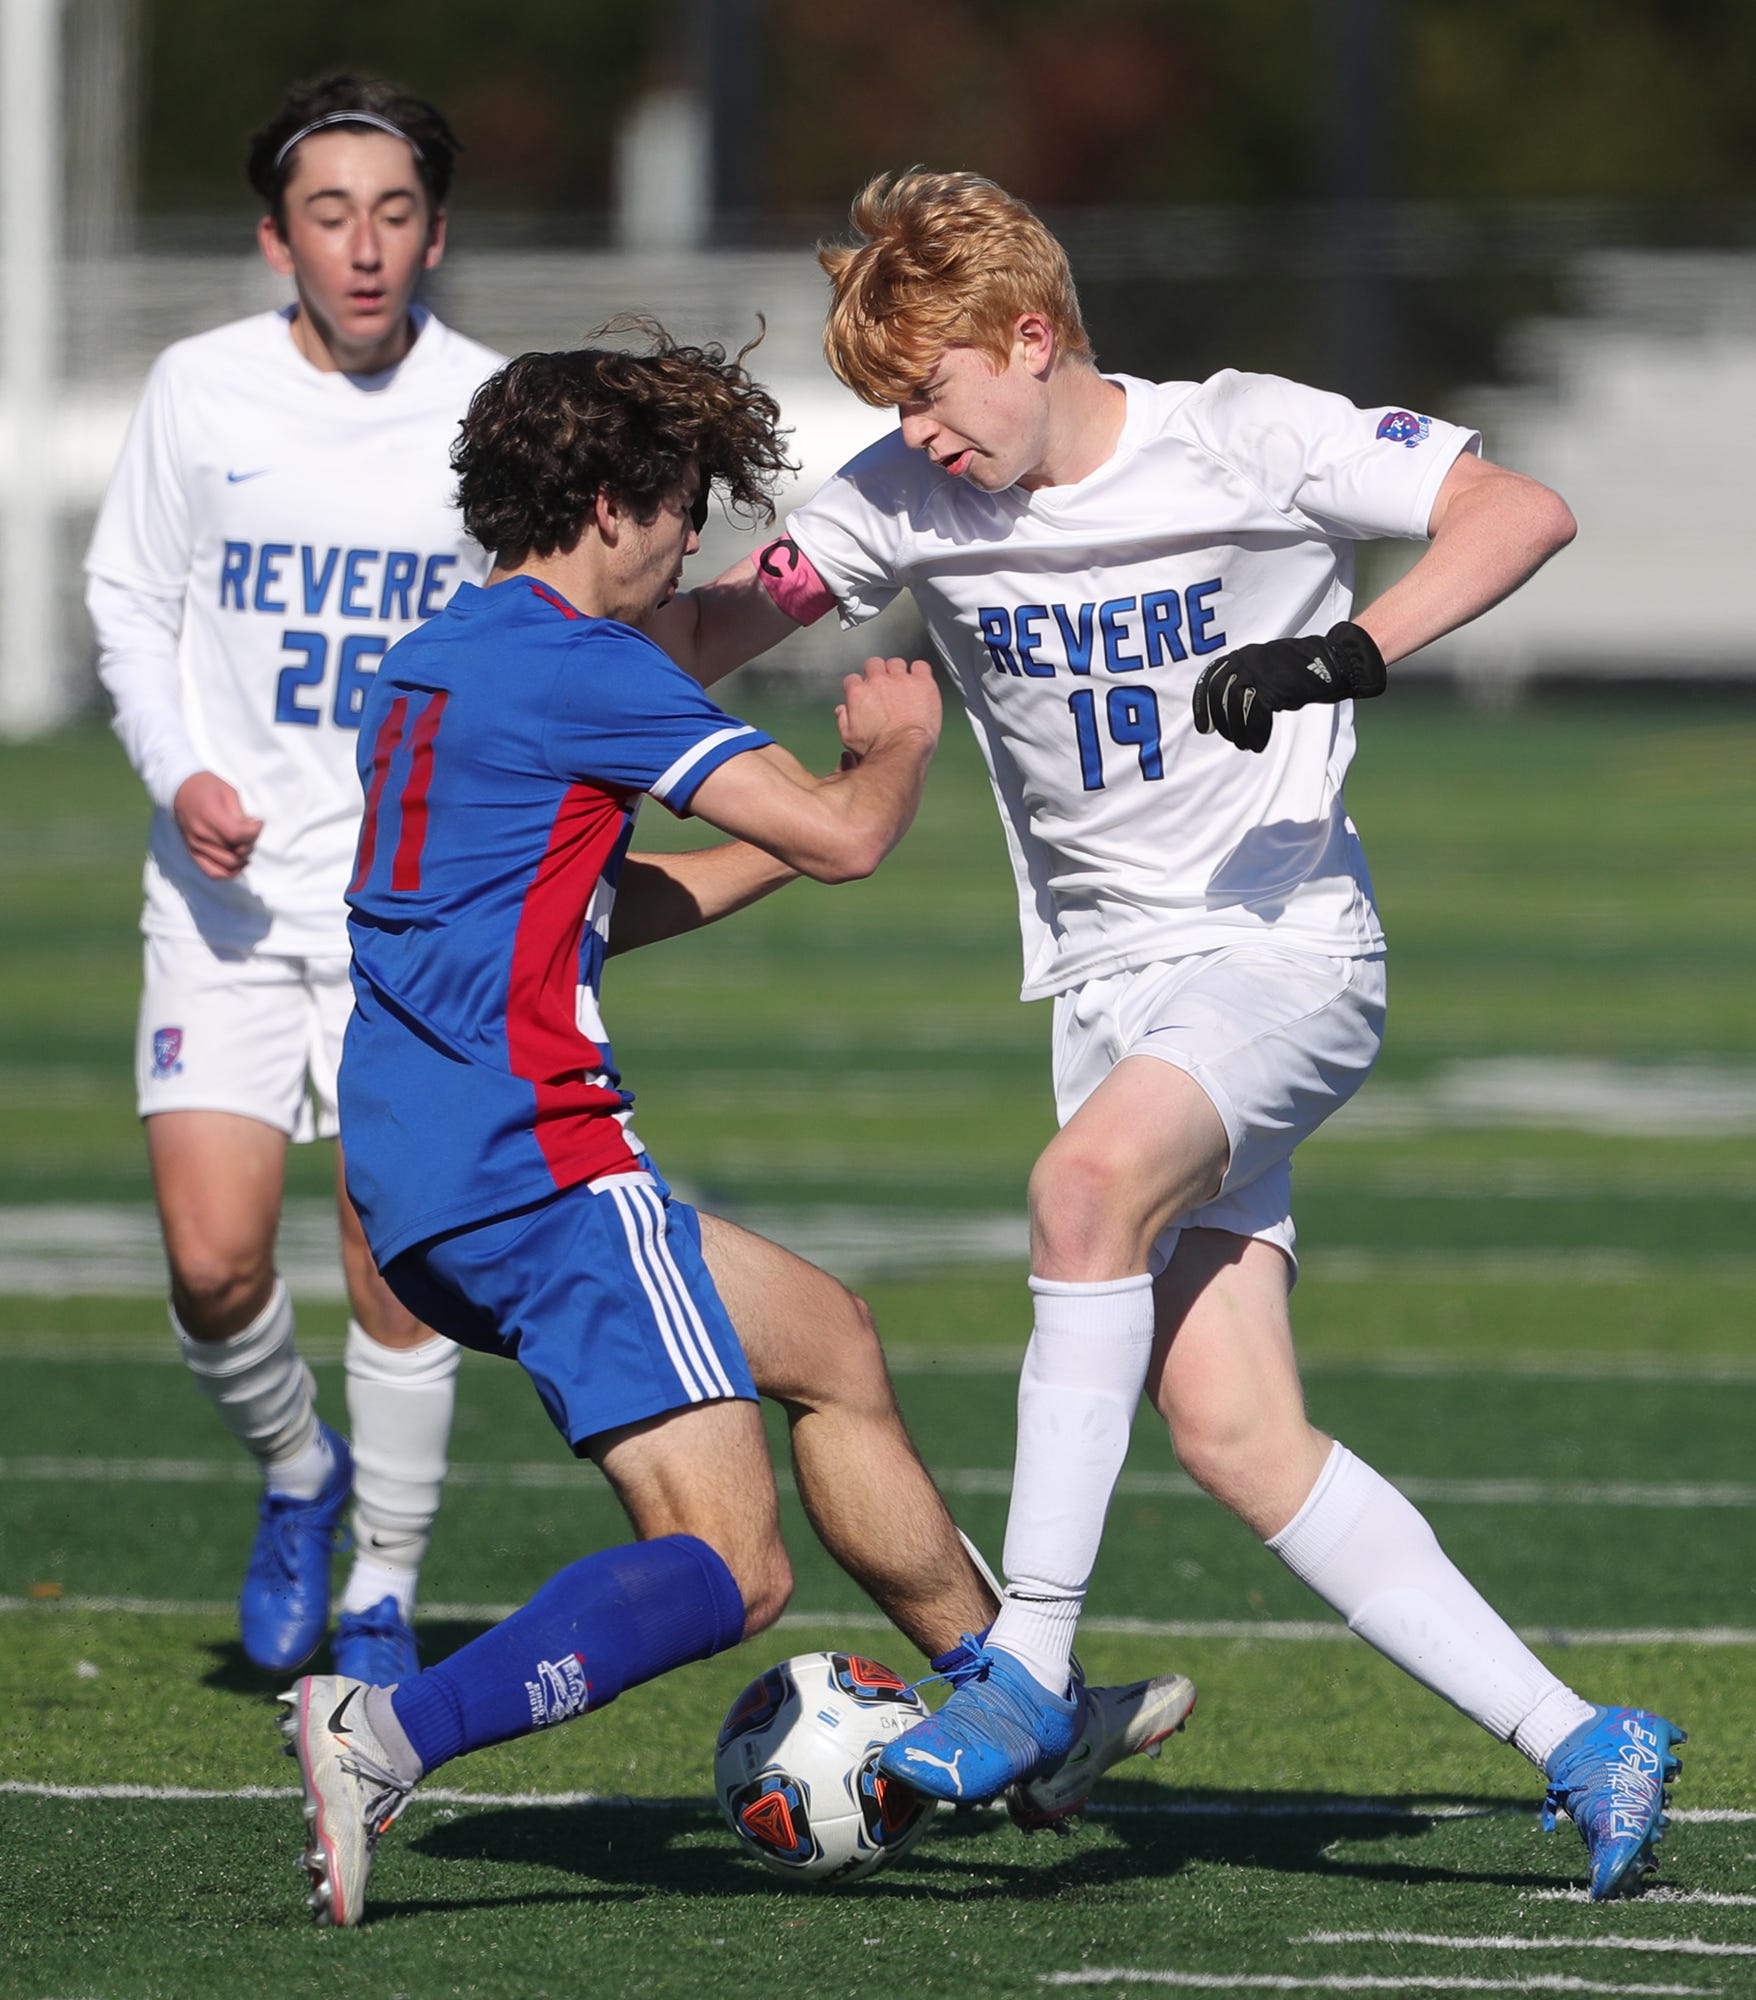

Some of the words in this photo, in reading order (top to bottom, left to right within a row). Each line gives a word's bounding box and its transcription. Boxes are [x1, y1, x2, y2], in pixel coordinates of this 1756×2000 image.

[219, 539, 459, 621] REVERE
[760, 539, 799, 578] C
[977, 577, 1227, 678] REVERE
[274, 629, 389, 730] 26
[1067, 684, 1165, 792] 19
[348, 690, 449, 893] 11
